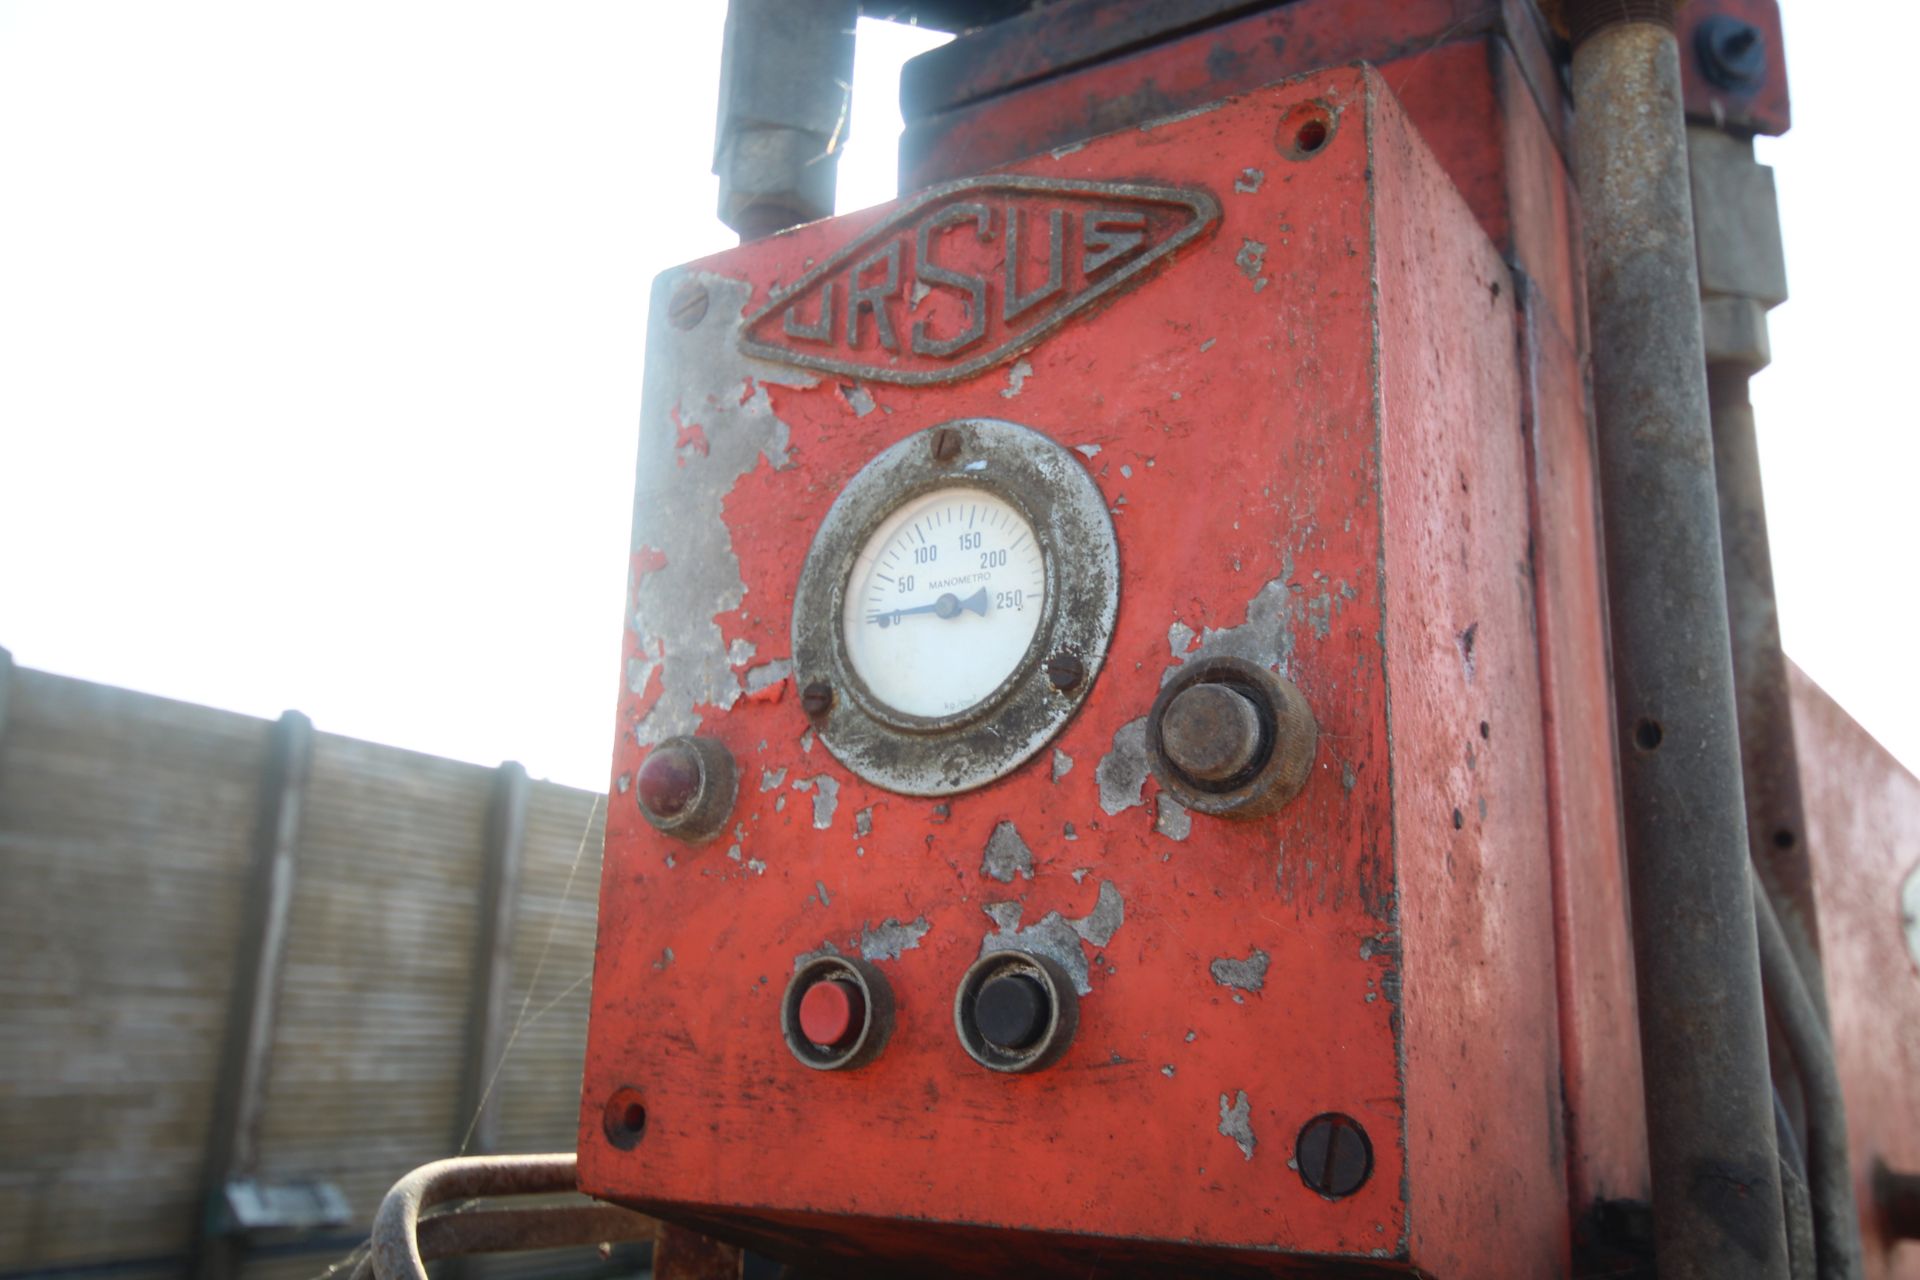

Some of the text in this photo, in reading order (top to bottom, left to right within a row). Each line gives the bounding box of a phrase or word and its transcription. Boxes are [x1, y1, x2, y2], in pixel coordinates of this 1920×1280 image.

[783, 202, 1146, 356] URSUS
[959, 532, 981, 551] 150
[914, 545, 937, 564] 100
[980, 549, 1006, 569] 200
[898, 575, 914, 593] 50
[929, 572, 991, 590] MANOMETRO
[997, 589, 1021, 609] 250
